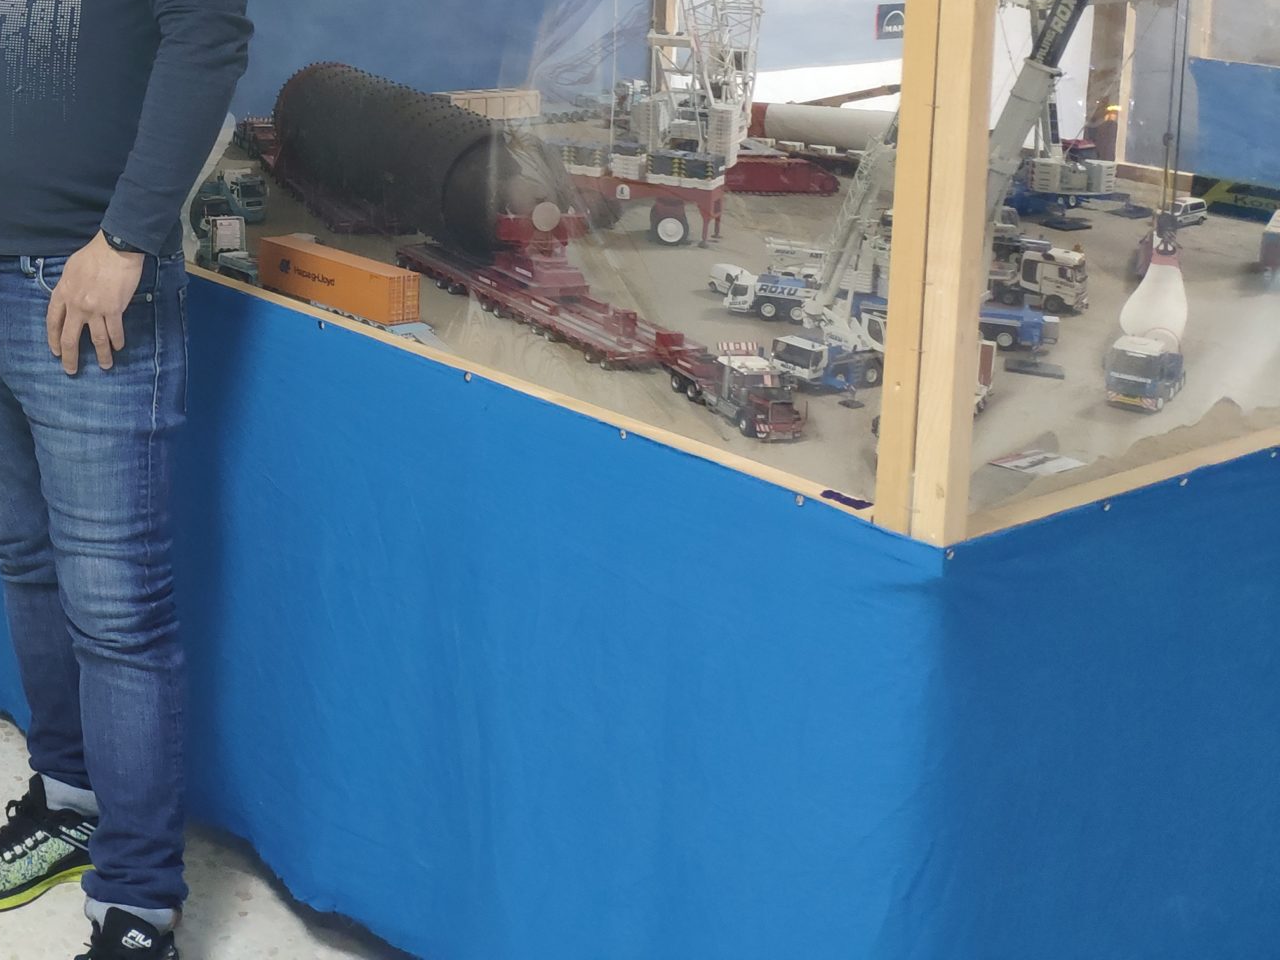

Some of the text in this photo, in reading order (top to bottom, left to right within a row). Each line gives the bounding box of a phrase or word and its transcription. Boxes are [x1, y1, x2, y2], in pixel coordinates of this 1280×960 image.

[293, 266, 336, 287] Hapag-Lloyd
[758, 283, 799, 297] ROXU
[127, 929, 152, 948] FILA
